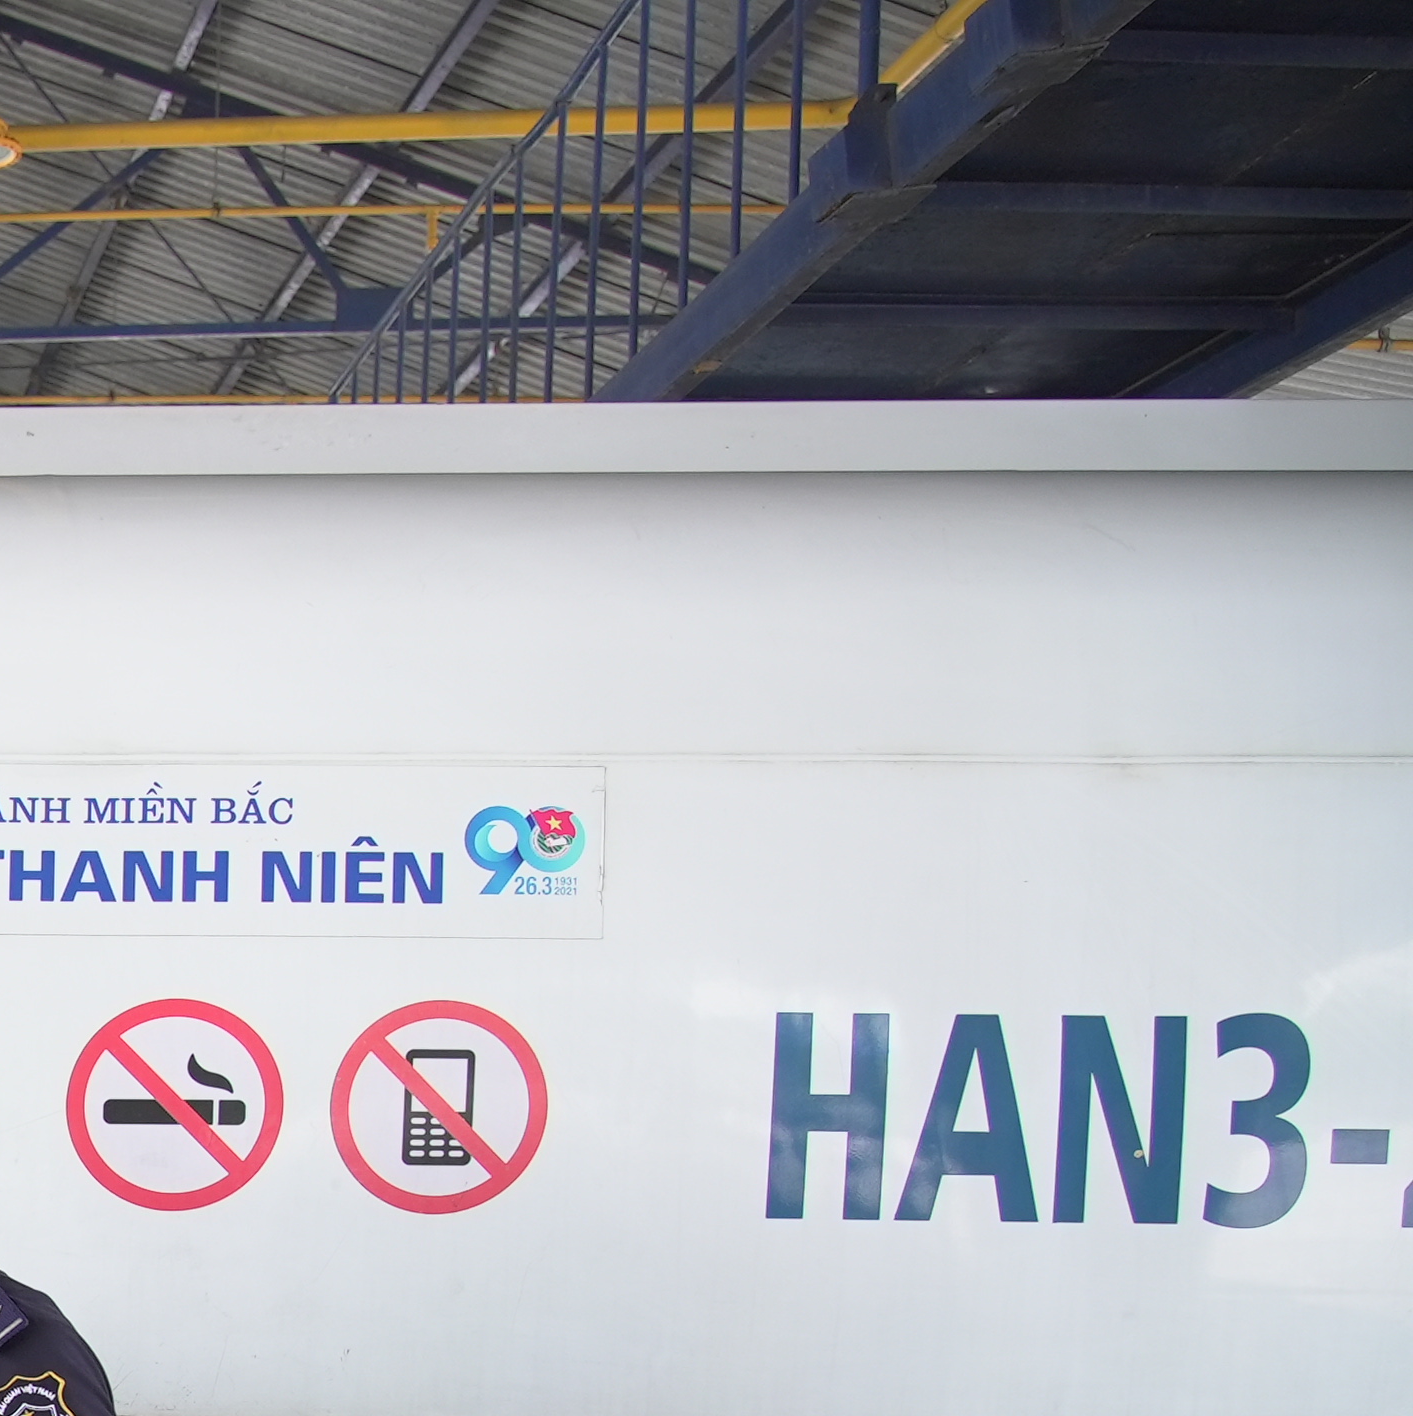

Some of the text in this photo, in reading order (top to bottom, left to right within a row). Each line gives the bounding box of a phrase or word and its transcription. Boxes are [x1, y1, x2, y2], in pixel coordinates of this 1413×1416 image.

[85, 782, 197, 826] MIỀN
[212, 781, 296, 826] BẮC
[262, 836, 446, 905] NIÊN
[514, 876, 553, 897] 26.3
[554, 877, 578, 886] 1931
[554, 886, 578, 896] 2021
[766, 1011, 1413, 1231] HAN3-
